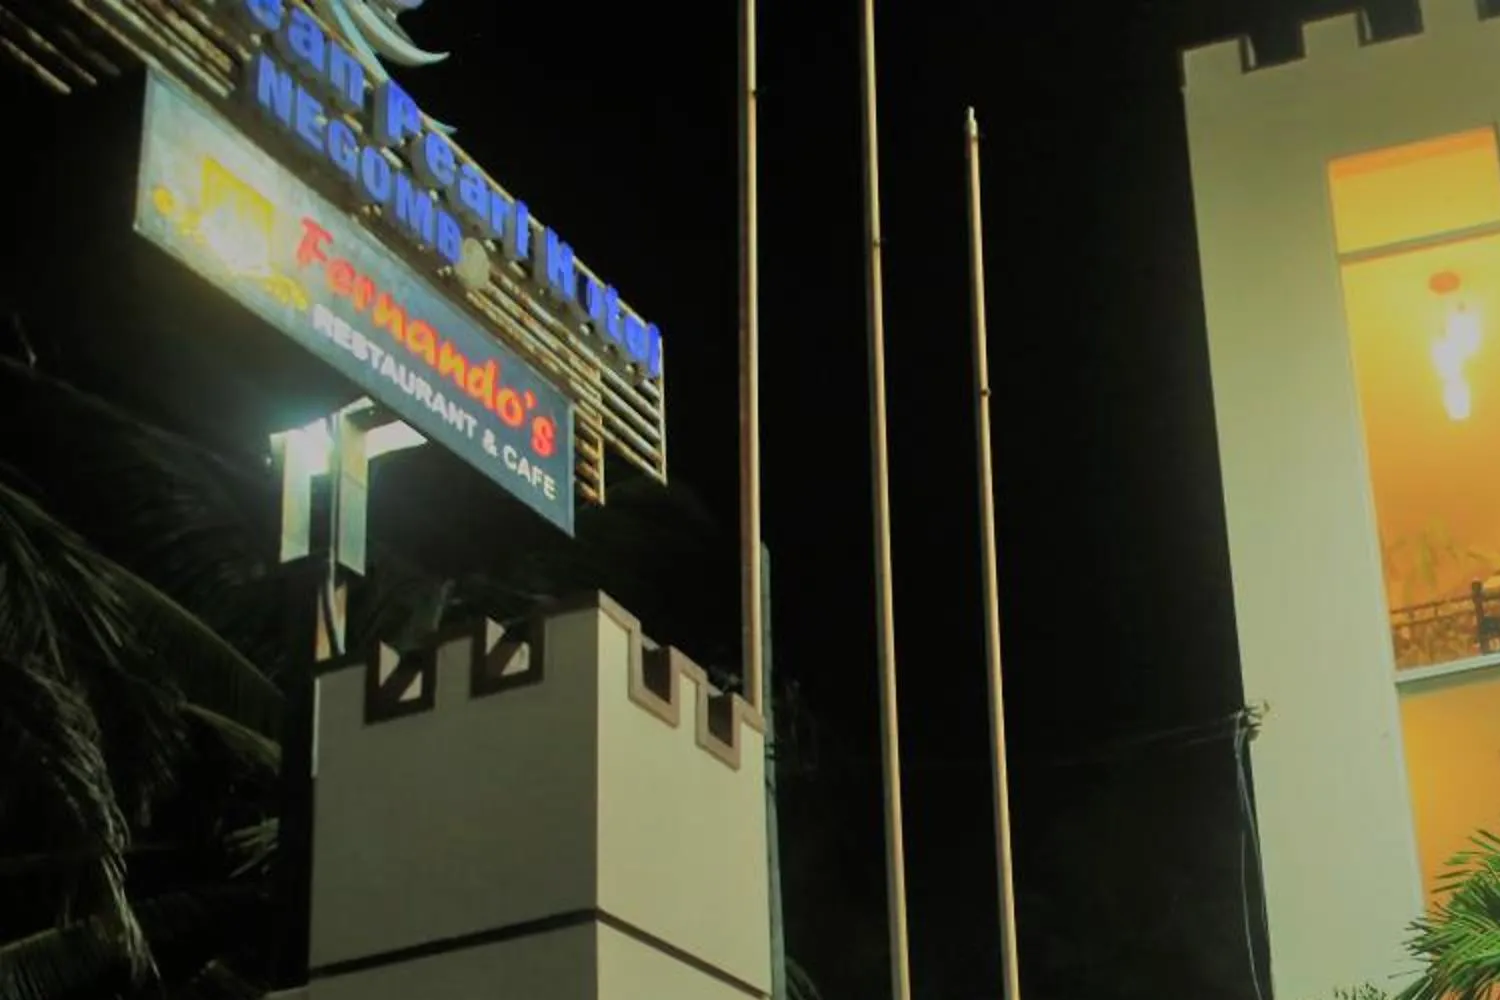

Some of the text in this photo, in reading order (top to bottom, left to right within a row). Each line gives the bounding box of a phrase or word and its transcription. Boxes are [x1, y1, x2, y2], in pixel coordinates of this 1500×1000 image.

[257, 51, 490, 288] NEGOMBO
[386, 80, 529, 259] Pearl
[297, 214, 557, 457] Fernando's
[312, 304, 557, 500] RESTAURANT & CAFE
